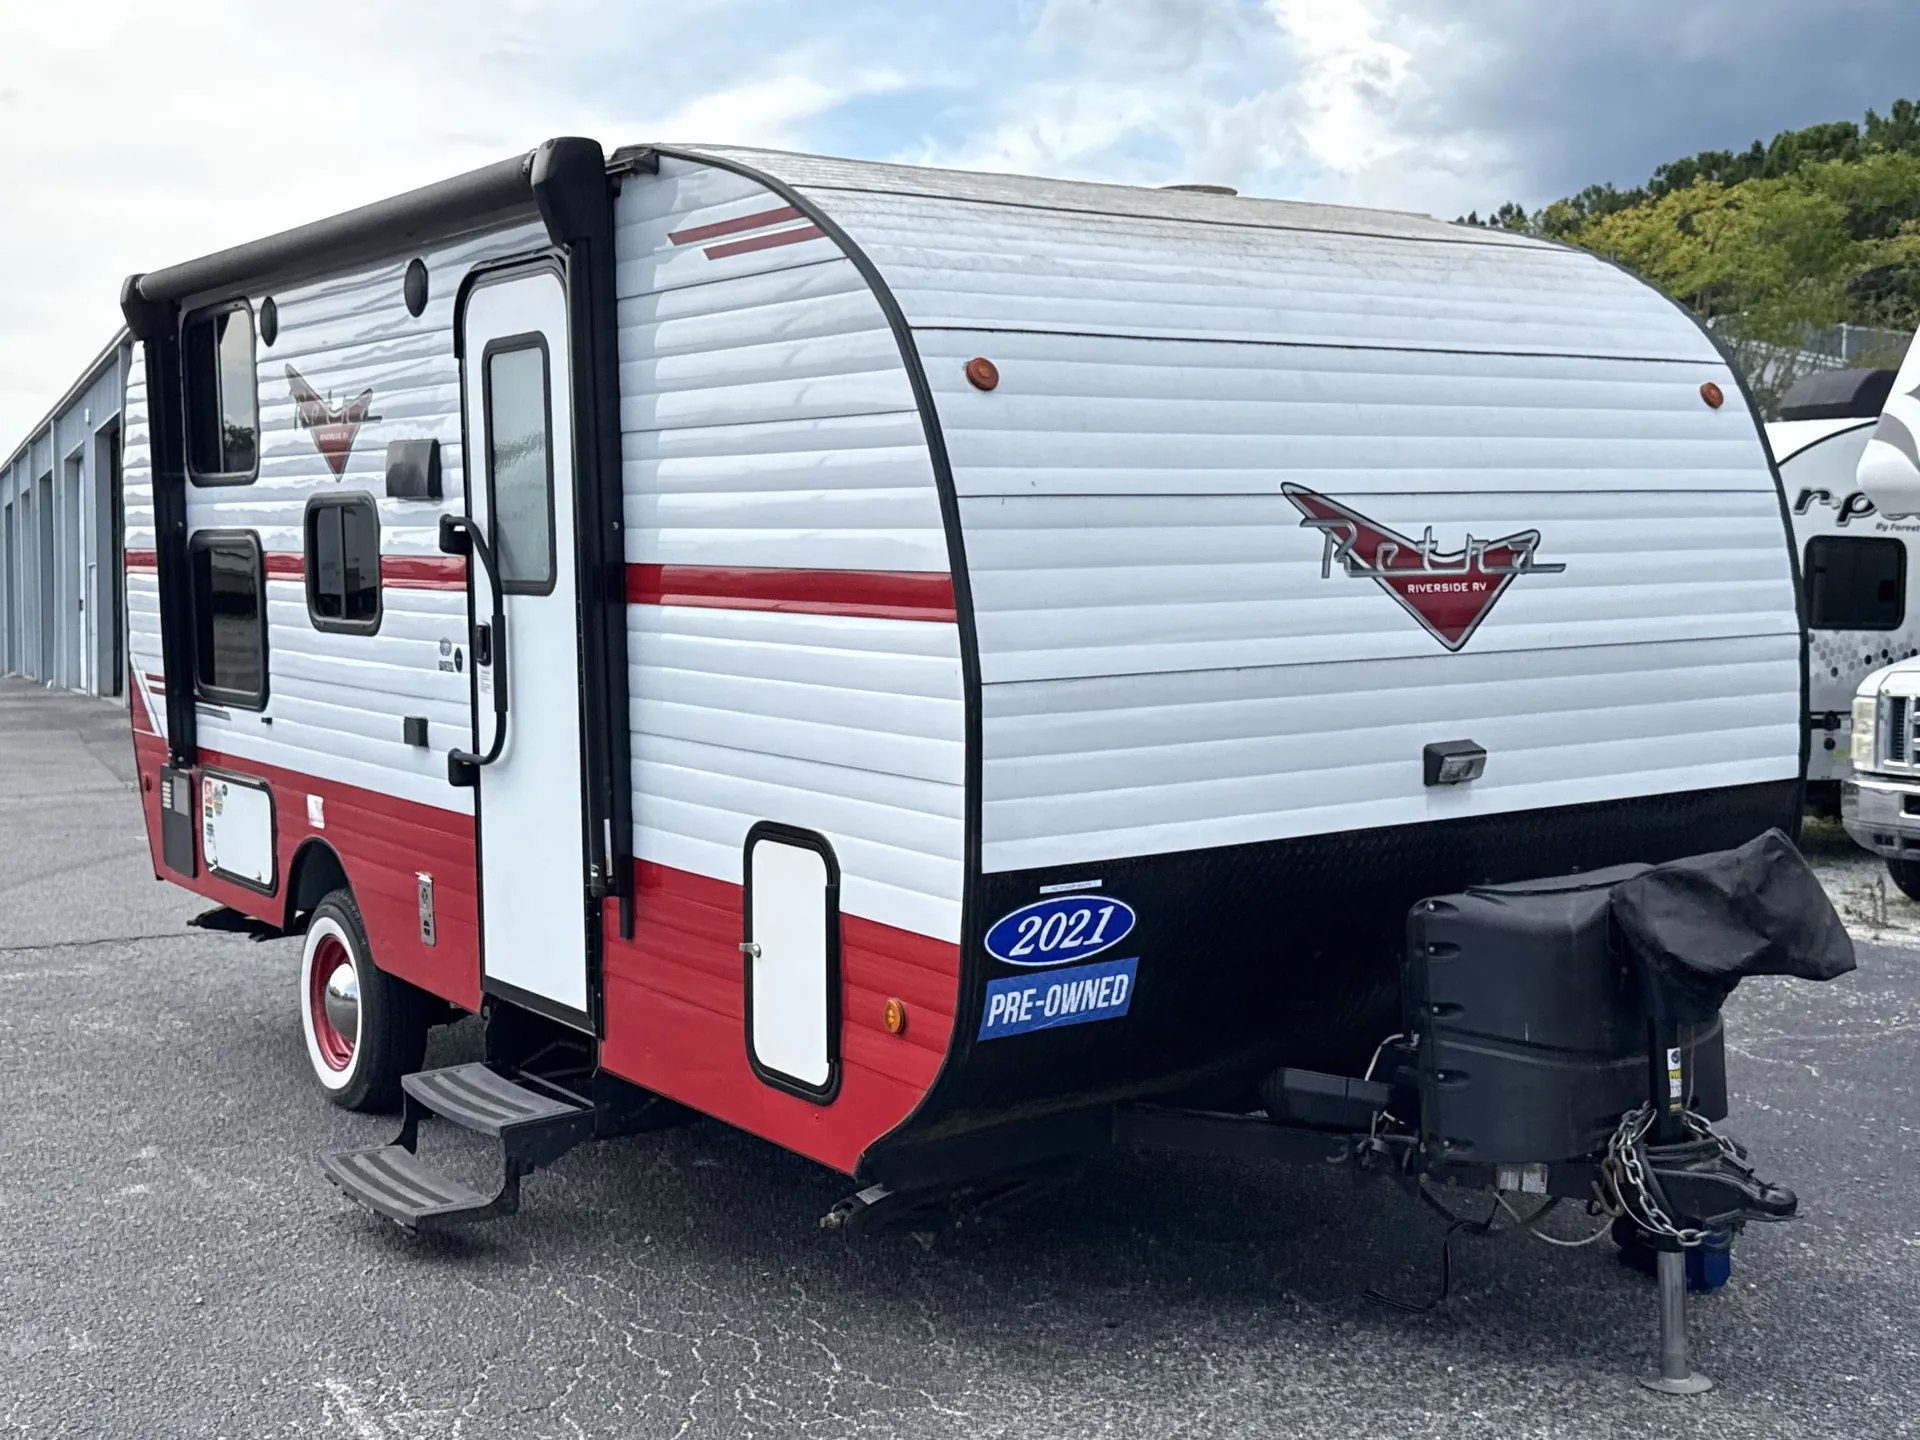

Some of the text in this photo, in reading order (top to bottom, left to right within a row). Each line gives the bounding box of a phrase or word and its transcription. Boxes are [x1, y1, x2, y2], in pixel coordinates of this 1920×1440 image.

[1407, 581, 1487, 594] RIVERSIDE RV
[1008, 905, 1115, 957] 2021
[987, 973, 1130, 1028] PRE-OWNED
